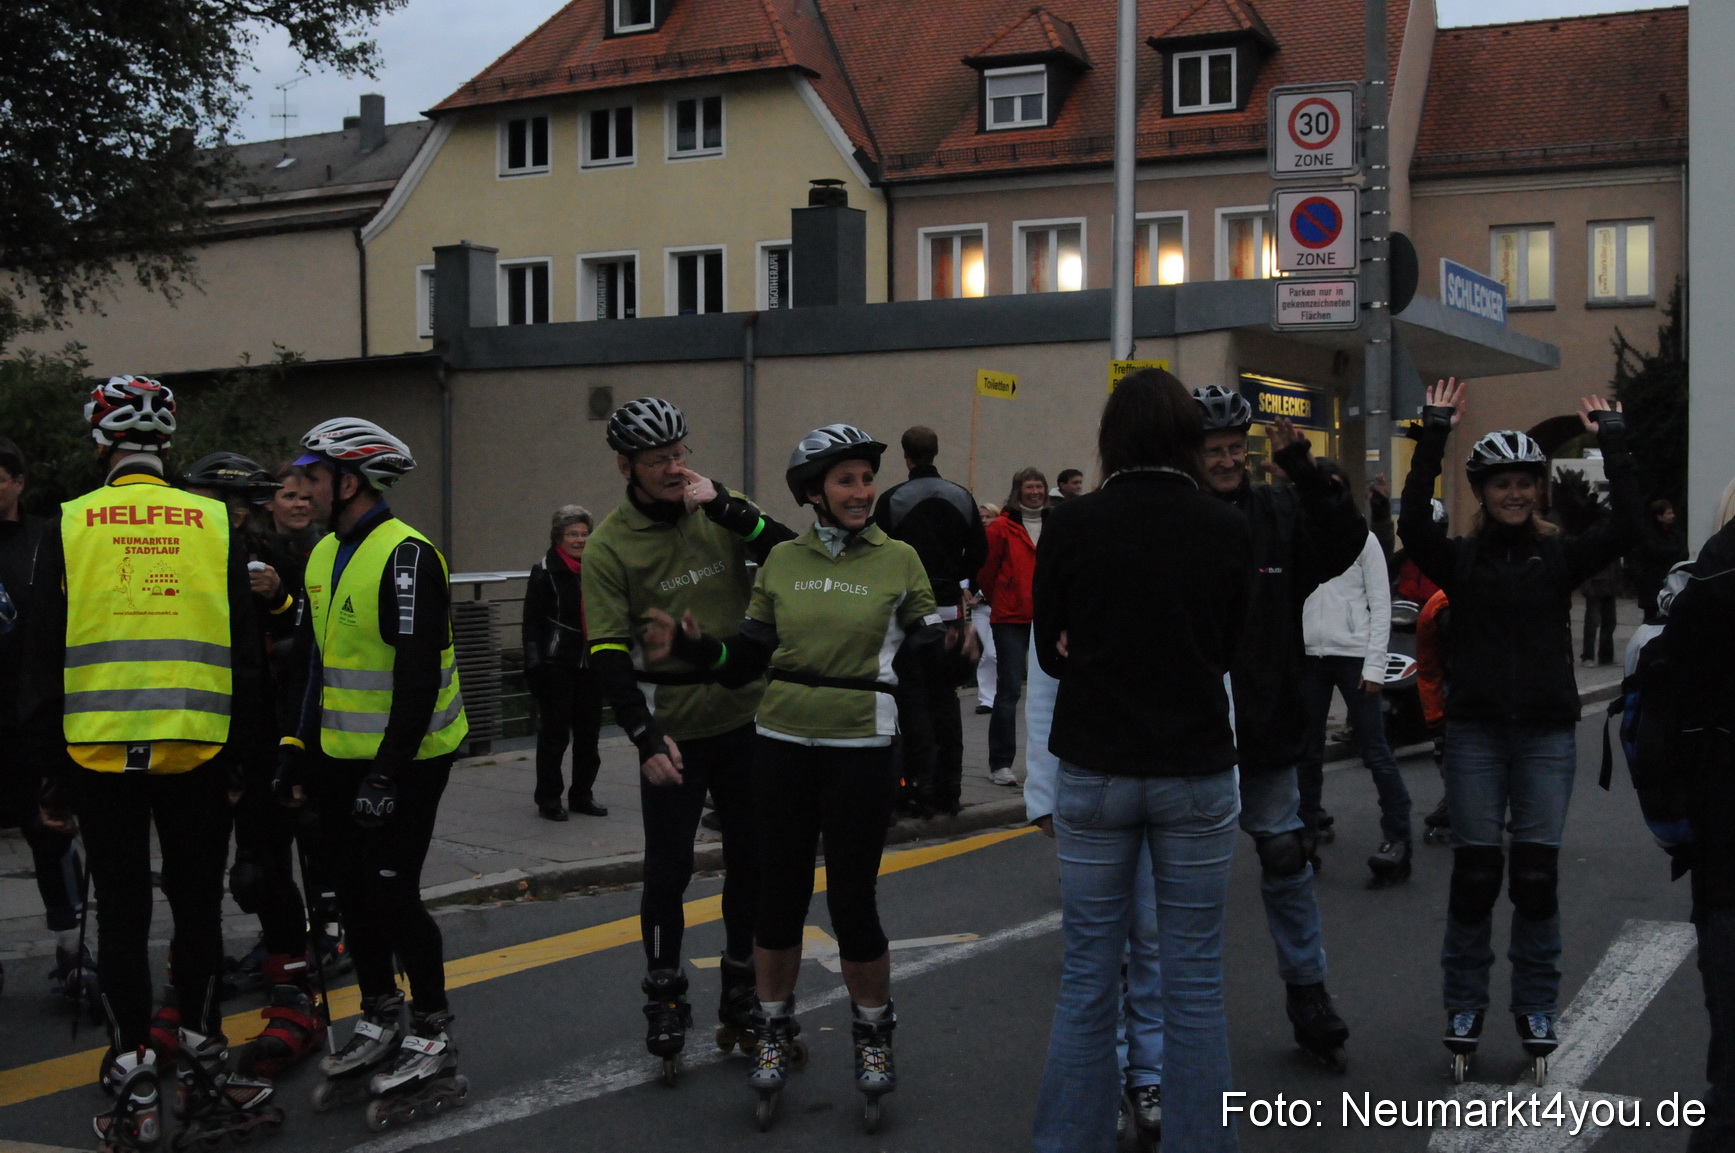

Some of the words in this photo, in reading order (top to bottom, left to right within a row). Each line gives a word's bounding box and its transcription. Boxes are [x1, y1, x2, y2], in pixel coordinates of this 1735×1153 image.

[1299, 112, 1329, 136] 30
[1294, 154, 1334, 167] ZONE
[1296, 253, 1336, 266] ZONE
[769, 251, 779, 309] ERGOTHERAPIE
[1289, 288, 1316, 297] Parken
[1336, 287, 1344, 296] in
[1447, 272, 1505, 323] SCHLECKER
[1282, 300, 1351, 311] gekennzeichneten
[1301, 311, 1331, 321] Flächen
[983, 377, 1010, 392] Toiletten
[1258, 391, 1312, 417] SCHLECKER
[86, 505, 204, 529] HELFER
[112, 537, 180, 546] NEUMARKTER
[124, 547, 180, 555] STADTLAUF
[660, 574, 690, 591] EURO
[697, 560, 725, 580] POLES
[794, 579, 821, 591] EURO
[833, 581, 867, 596] POLES
